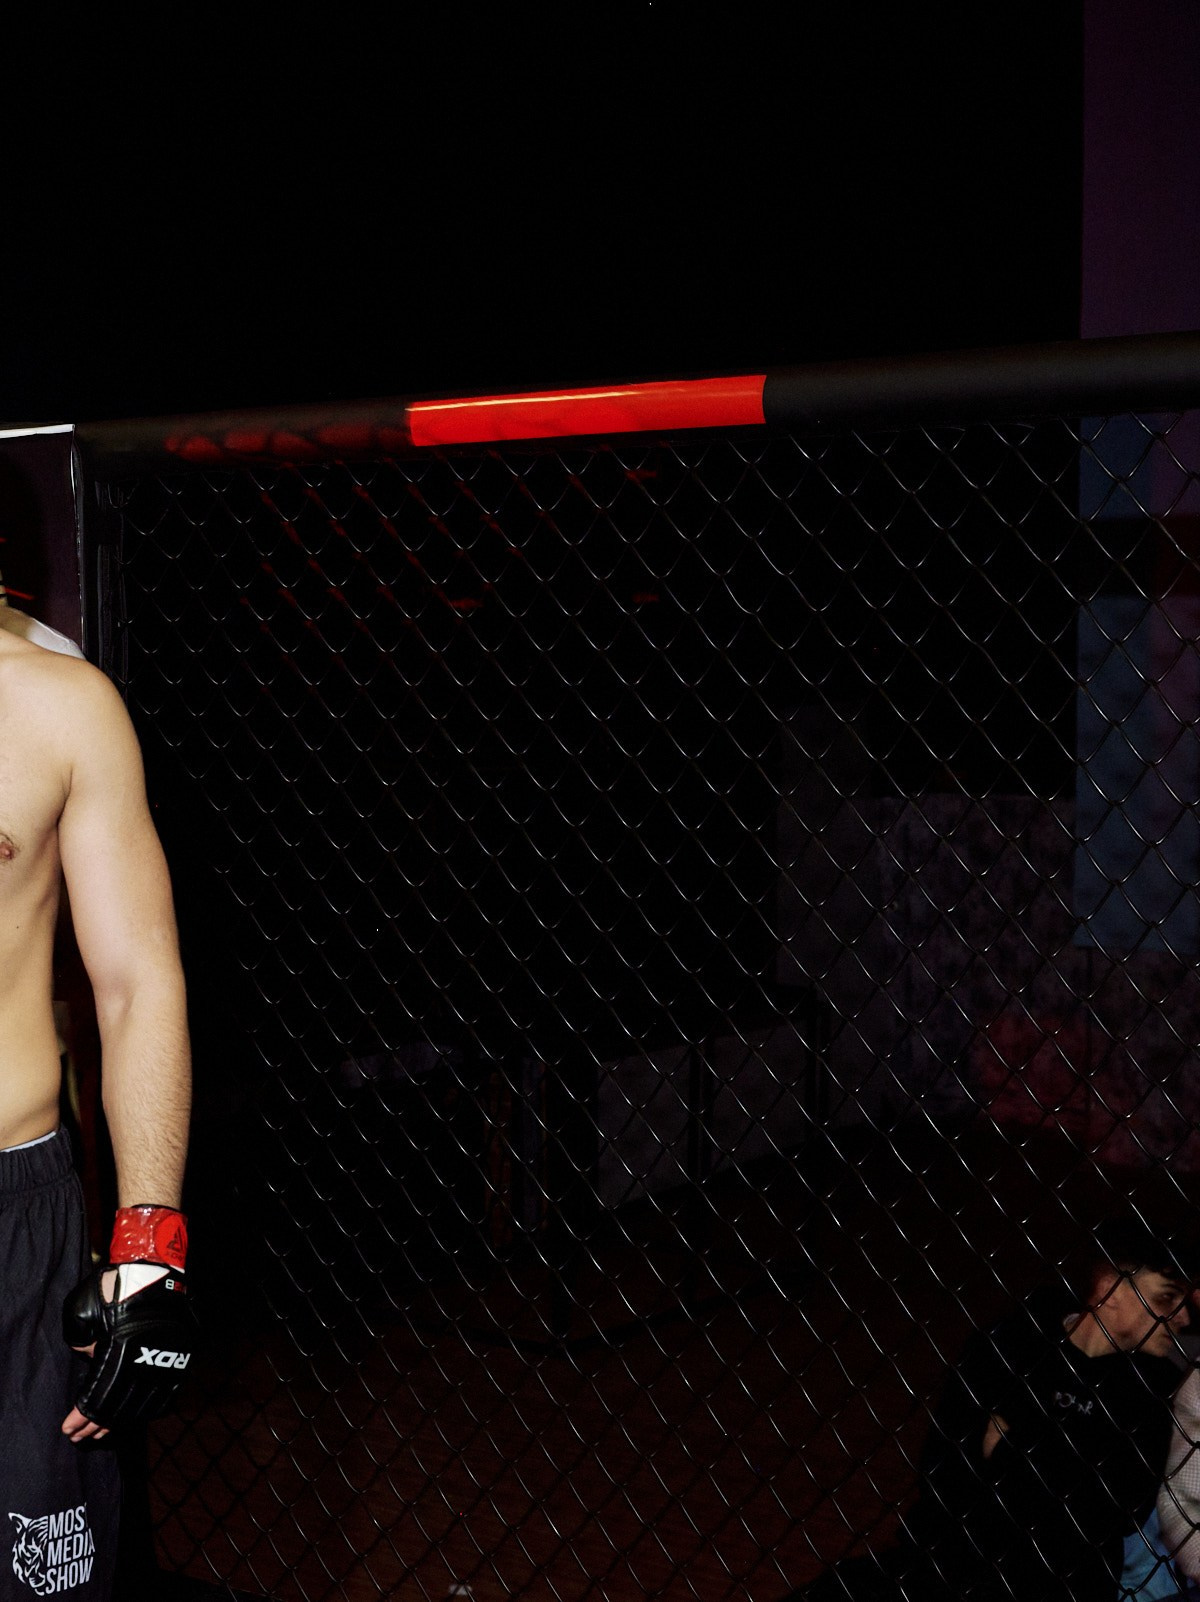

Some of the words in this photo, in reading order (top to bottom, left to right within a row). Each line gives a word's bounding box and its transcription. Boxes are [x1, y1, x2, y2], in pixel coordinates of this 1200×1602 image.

[134, 1347, 191, 1369] RDX
[48, 1506, 85, 1540] MOS
[45, 1556, 94, 1594] SHOW
